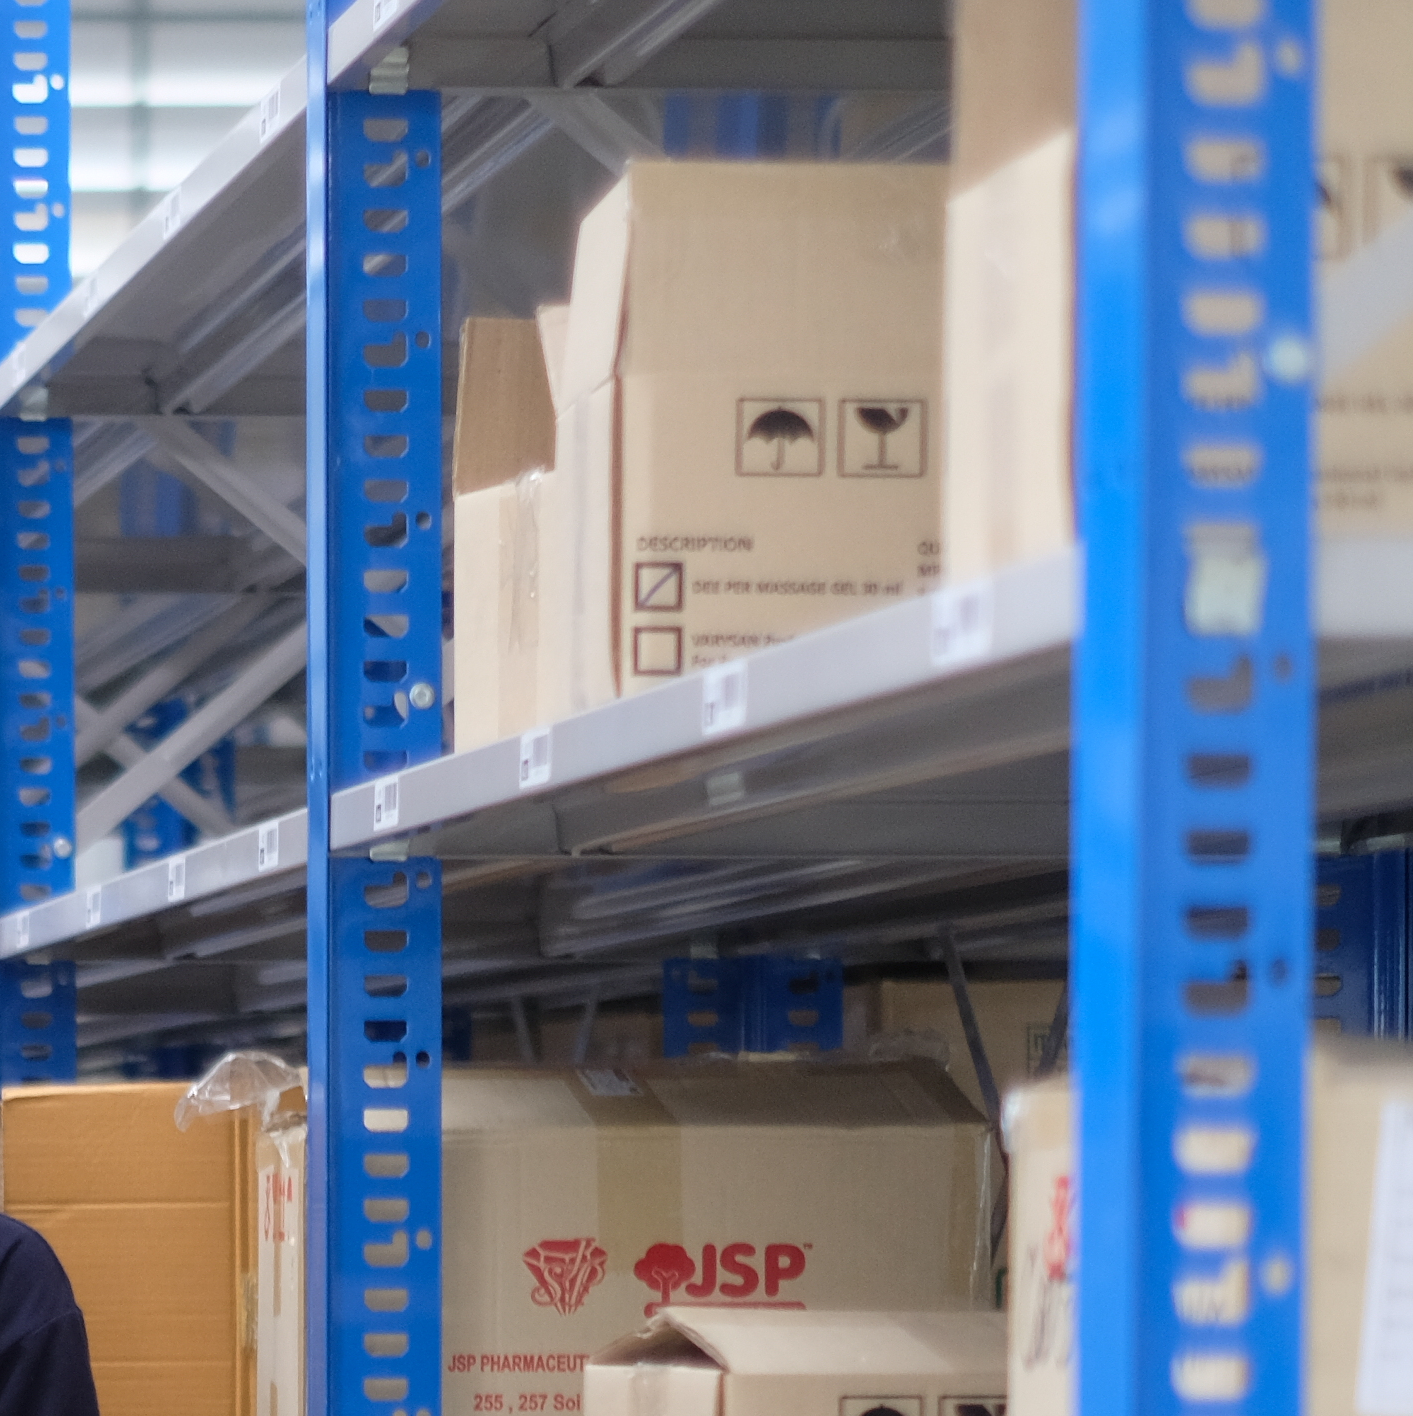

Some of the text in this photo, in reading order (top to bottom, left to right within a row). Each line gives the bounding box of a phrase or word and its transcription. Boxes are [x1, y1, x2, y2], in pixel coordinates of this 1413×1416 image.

[637, 536, 754, 554] DESCRIPTION
[756, 580, 827, 597] MASSAGE
[830, 580, 859, 596] GEL
[685, 1243, 805, 1298] JSP
[448, 1354, 476, 1373] JSP
[474, 1393, 504, 1412] 255
[518, 1393, 549, 1412] 257
